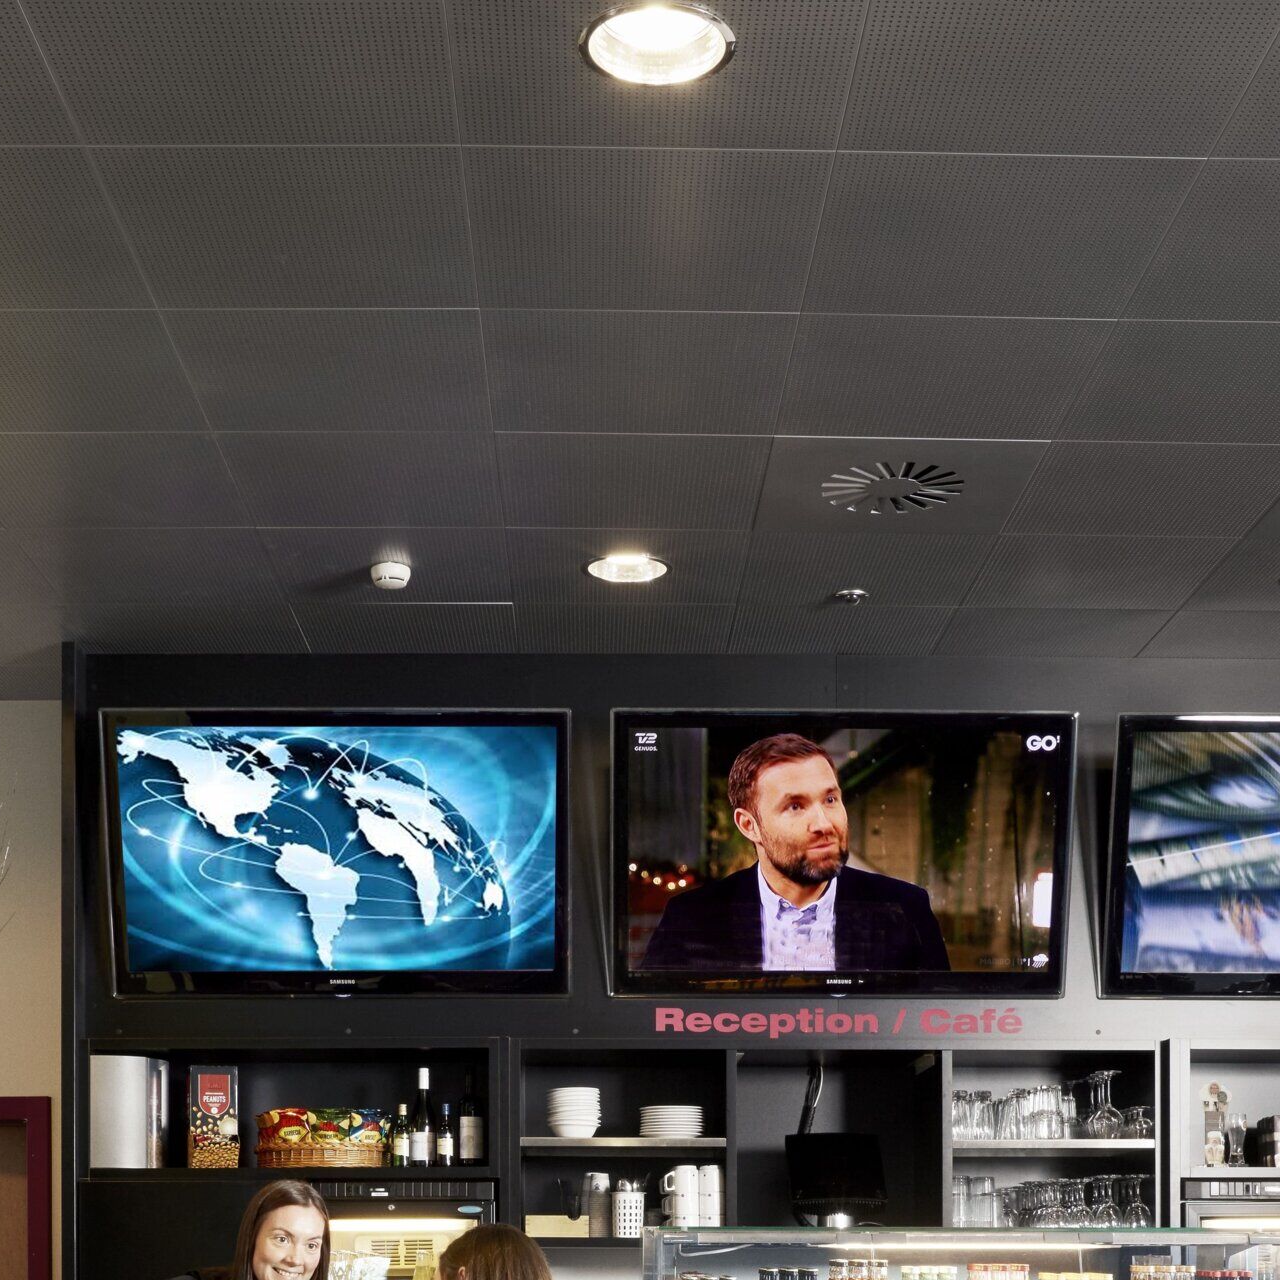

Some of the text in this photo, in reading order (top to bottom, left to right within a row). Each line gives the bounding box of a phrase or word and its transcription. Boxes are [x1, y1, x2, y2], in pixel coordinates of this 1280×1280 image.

[655, 1008, 879, 1039] Reception
[920, 1007, 1024, 1035] Café
[203, 1095, 226, 1103] PEANUTS
